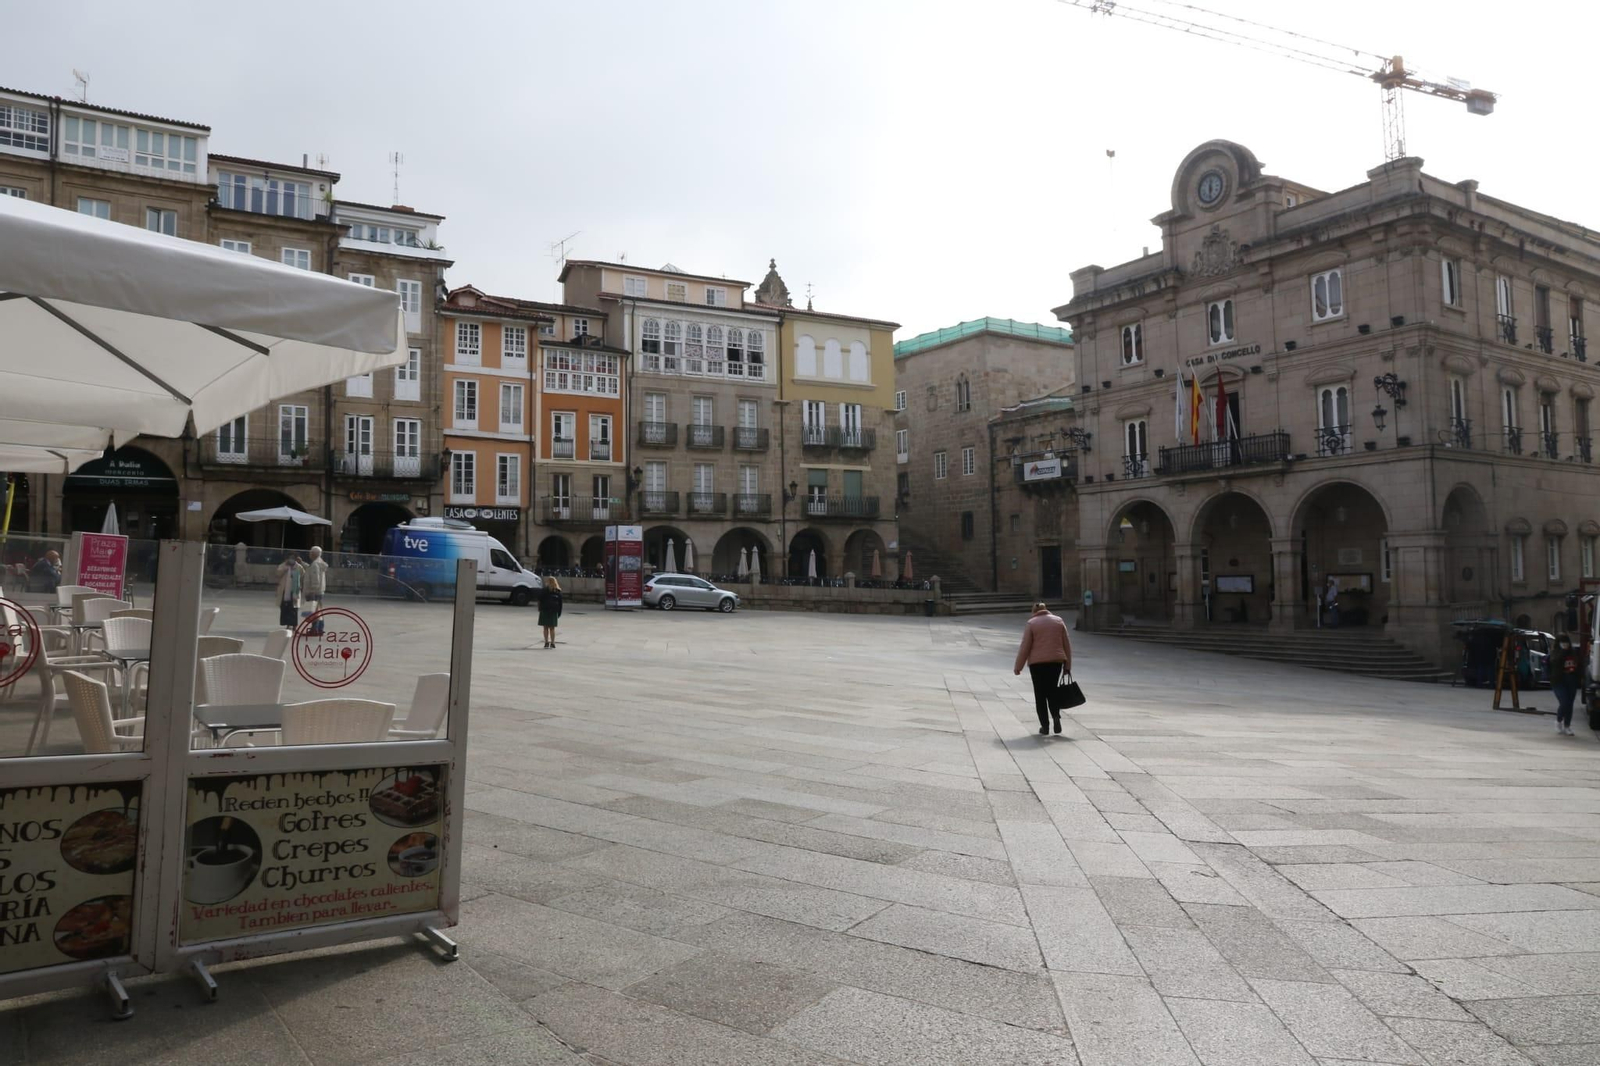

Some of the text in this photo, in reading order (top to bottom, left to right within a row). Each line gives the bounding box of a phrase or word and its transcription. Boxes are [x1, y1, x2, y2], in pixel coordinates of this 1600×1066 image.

[1186, 356, 1203, 367] CASA
[1221, 345, 1261, 359] CONCELLO
[444, 507, 465, 518] CASA
[494, 509, 518, 520] LENTES
[91, 537, 117, 548] Praza
[404, 536, 428, 552] tve
[223, 796, 289, 812] Recien
[293, 790, 355, 810] hechos
[278, 810, 367, 834] Gofres
[272, 837, 369, 862] Crepes
[261, 862, 376, 890] Churros
[192, 900, 267, 920] Variedad
[271, 901, 291, 909] en
[293, 888, 368, 908] chocolates
[239, 911, 309, 930] Tambien
[312, 906, 347, 922] para
